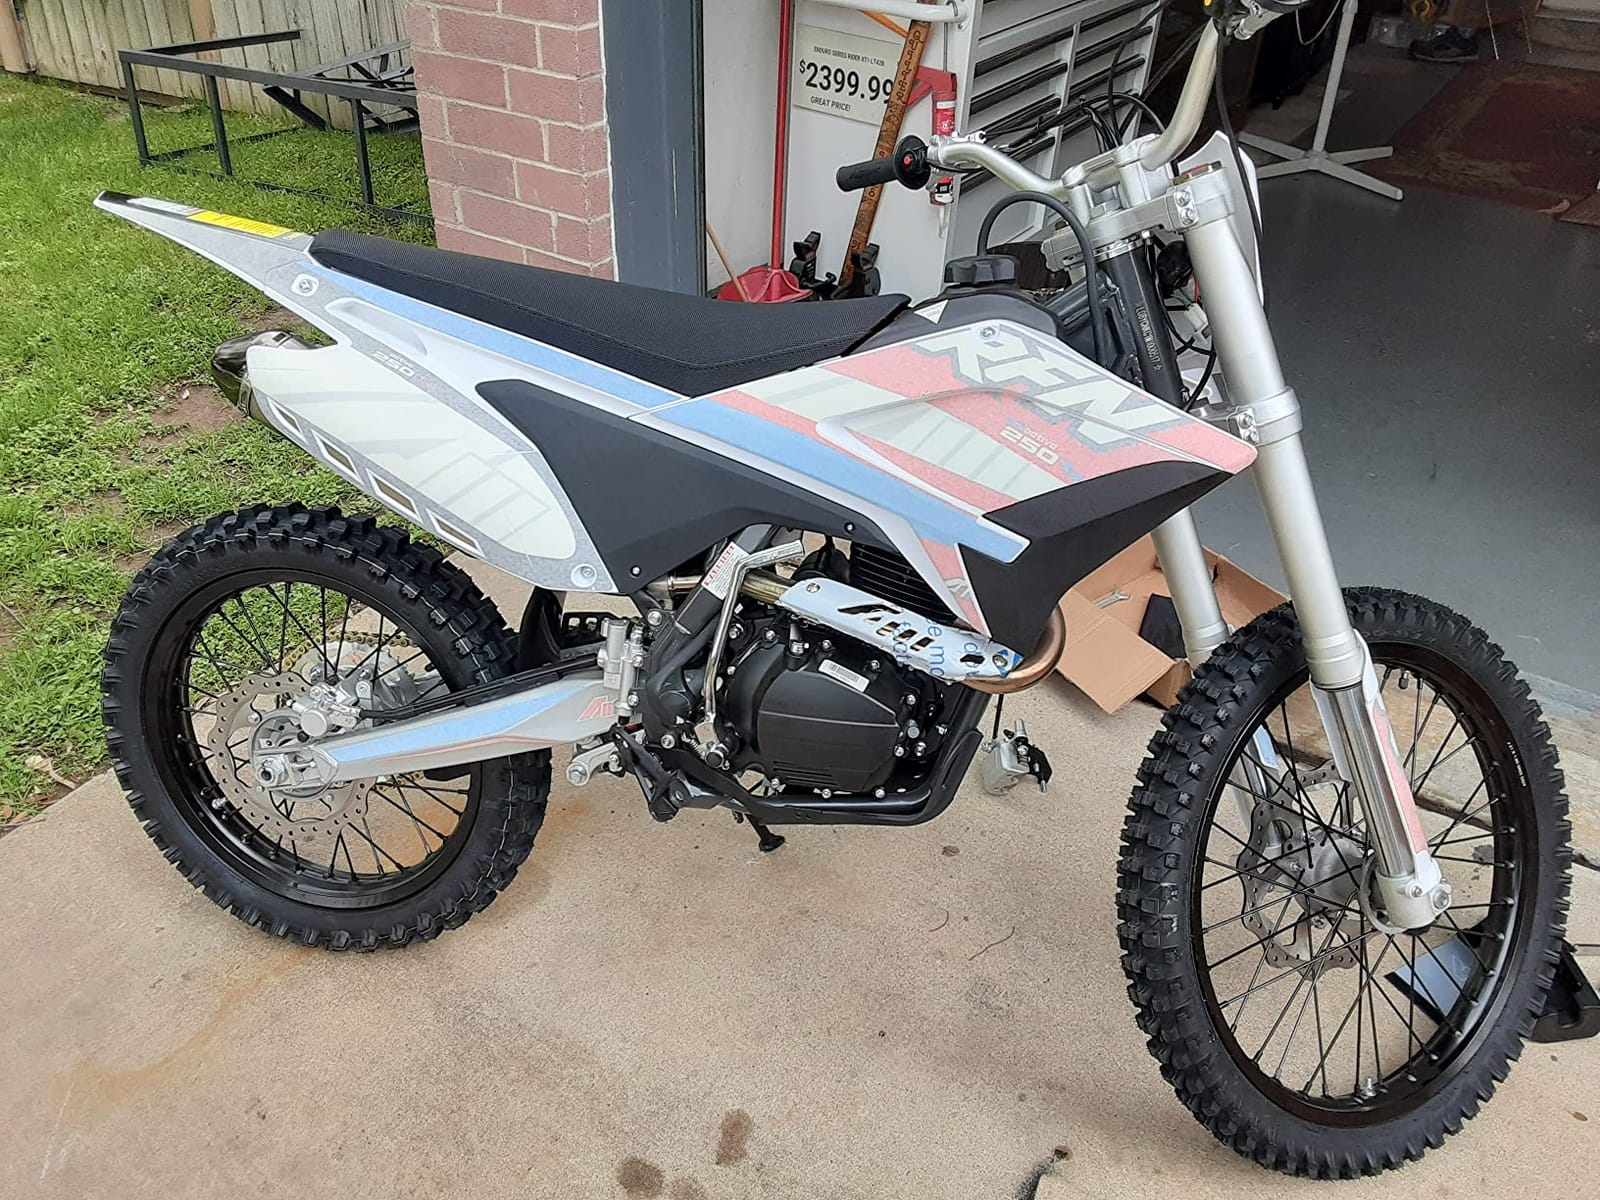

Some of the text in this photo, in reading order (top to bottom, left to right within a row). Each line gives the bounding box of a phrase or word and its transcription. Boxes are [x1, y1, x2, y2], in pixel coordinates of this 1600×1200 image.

[810, 96, 851, 111] GREAT PRICE!
[372, 350, 415, 377] 250
[999, 425, 1060, 465] 250
